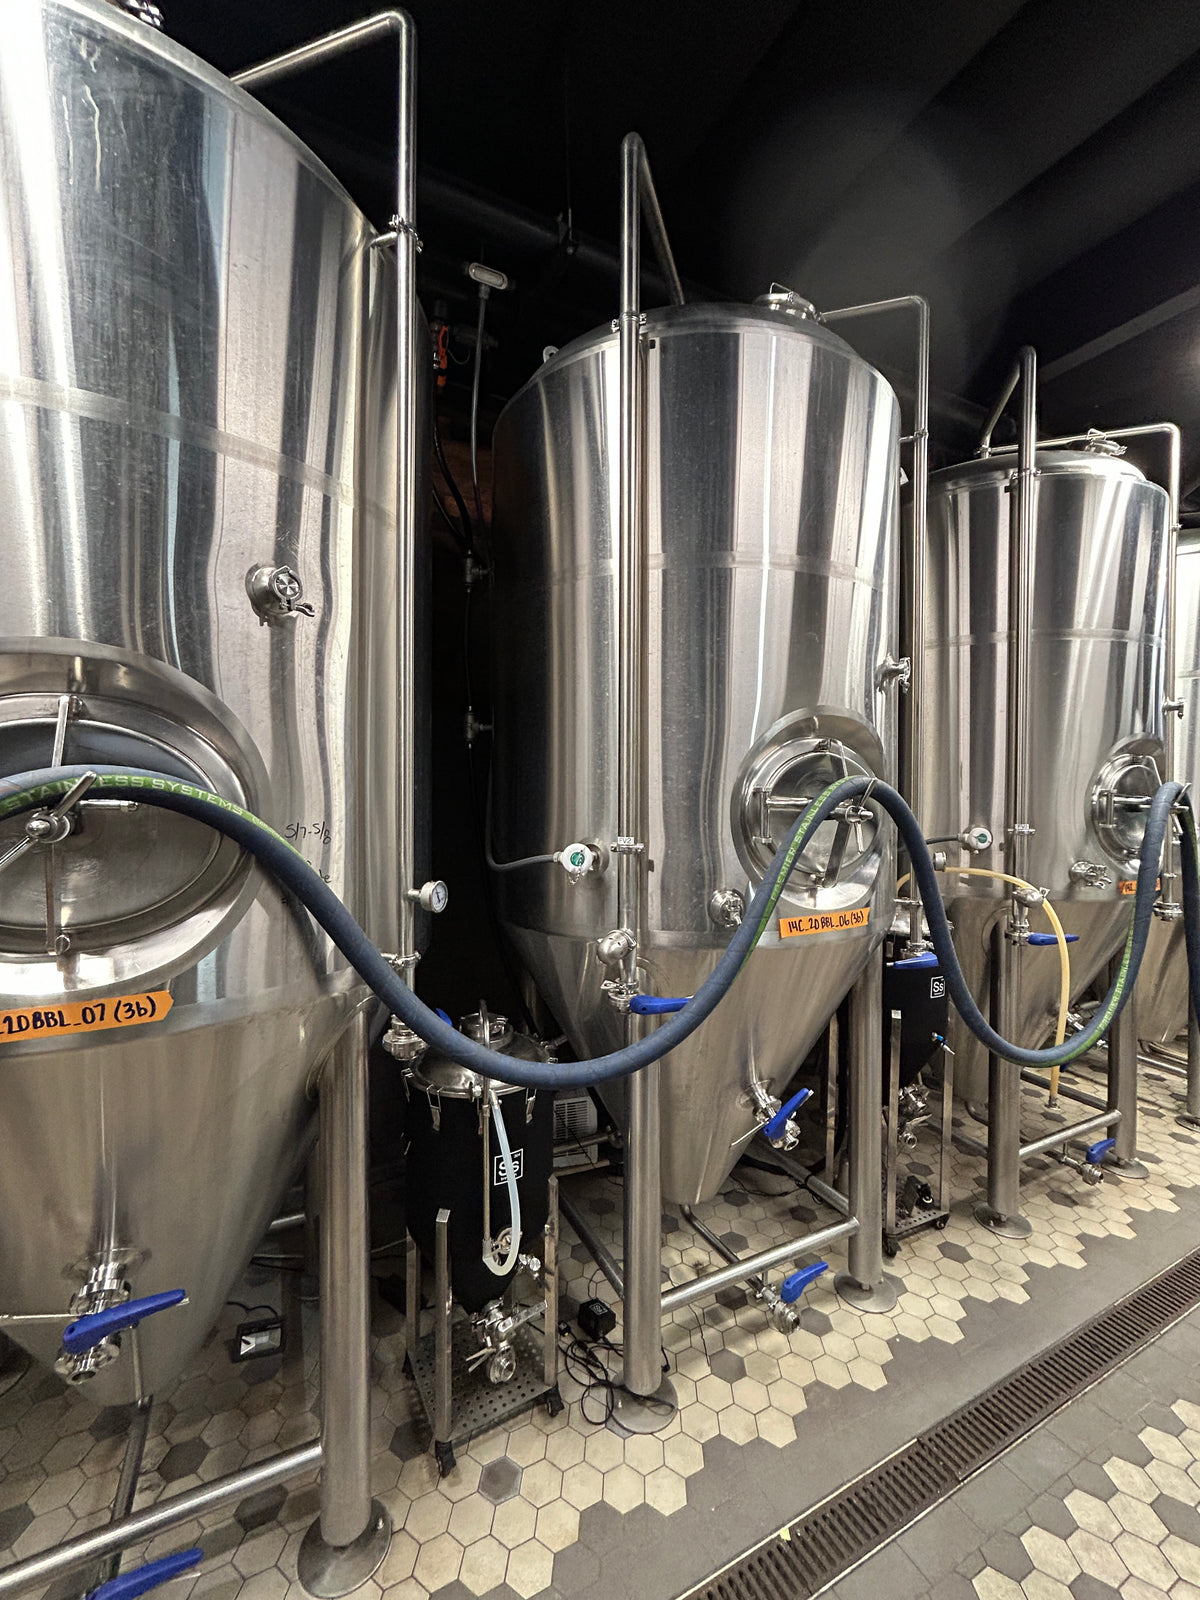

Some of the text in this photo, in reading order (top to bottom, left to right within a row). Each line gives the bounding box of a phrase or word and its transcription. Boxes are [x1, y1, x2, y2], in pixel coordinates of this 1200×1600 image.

[7, 775, 243, 816] STAINESS SYSTEMS
[933, 981, 944, 993] Ss
